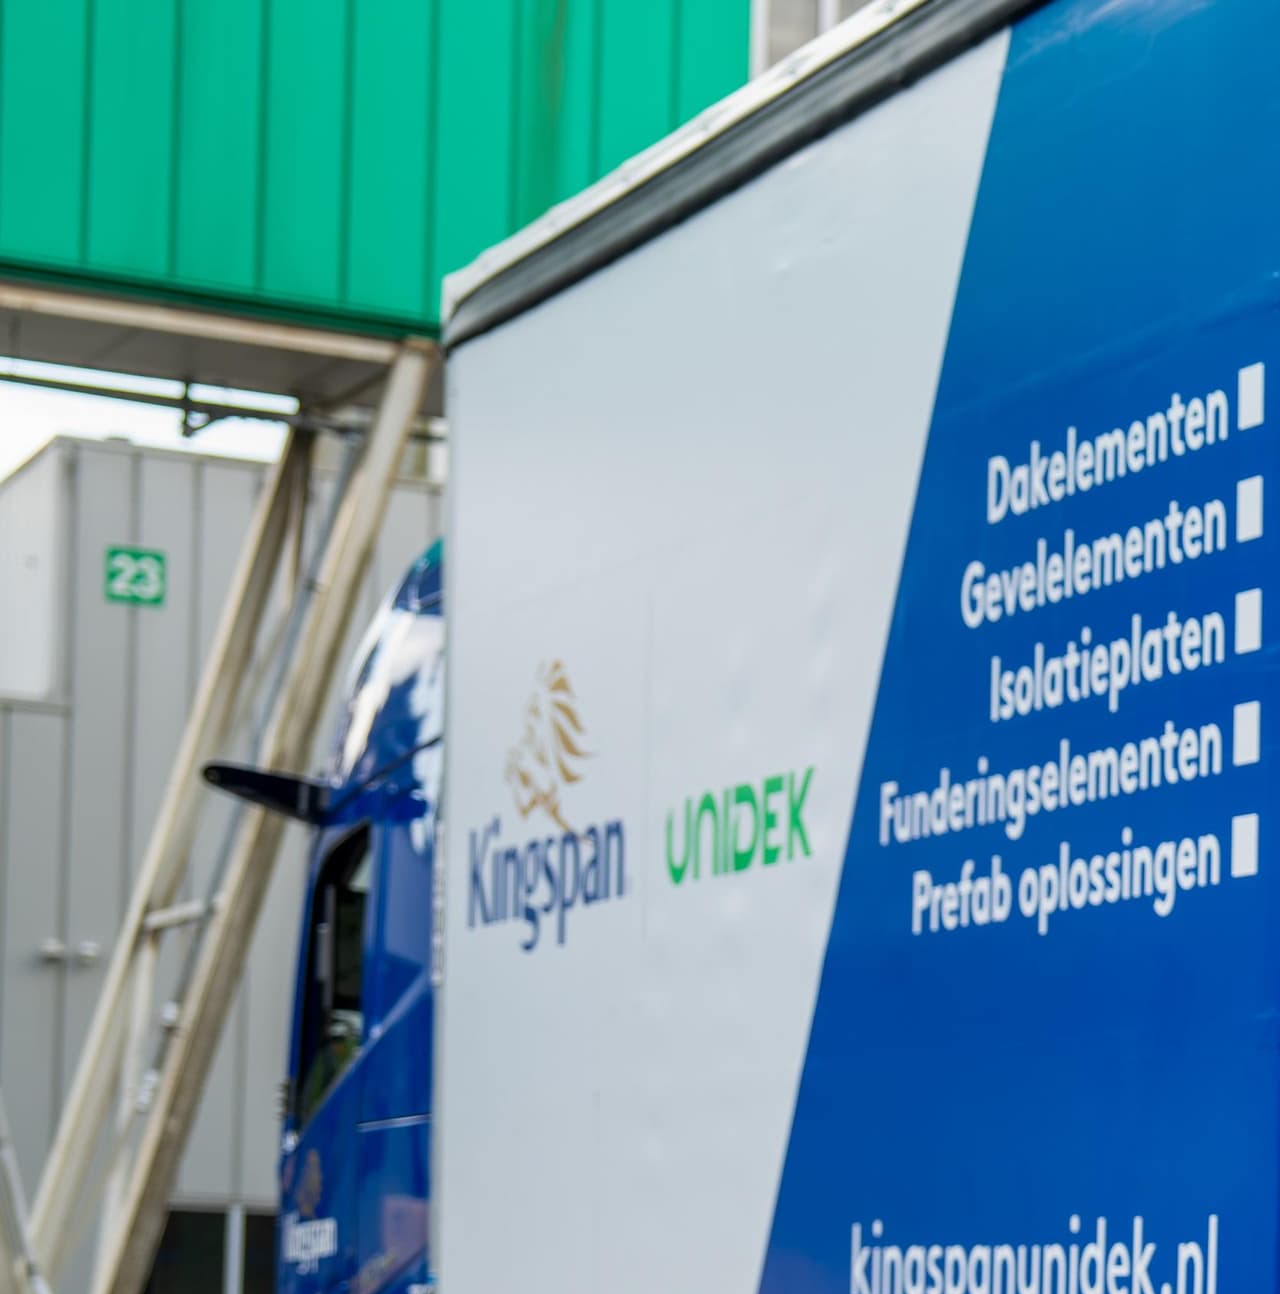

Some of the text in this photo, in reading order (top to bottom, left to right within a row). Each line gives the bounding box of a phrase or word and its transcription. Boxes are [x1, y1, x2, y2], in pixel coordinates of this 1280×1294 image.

[986, 387, 1229, 524] Dakelementen
[111, 554, 164, 599] 23
[961, 497, 1226, 629] Gevelelementen
[990, 607, 1225, 722] Isolatieplaten
[665, 767, 817, 885] UNIDEK
[879, 721, 1223, 845] Funderingselementen
[467, 817, 627, 952] Kingspan
[911, 829, 1221, 935] Prefab oplossingen
